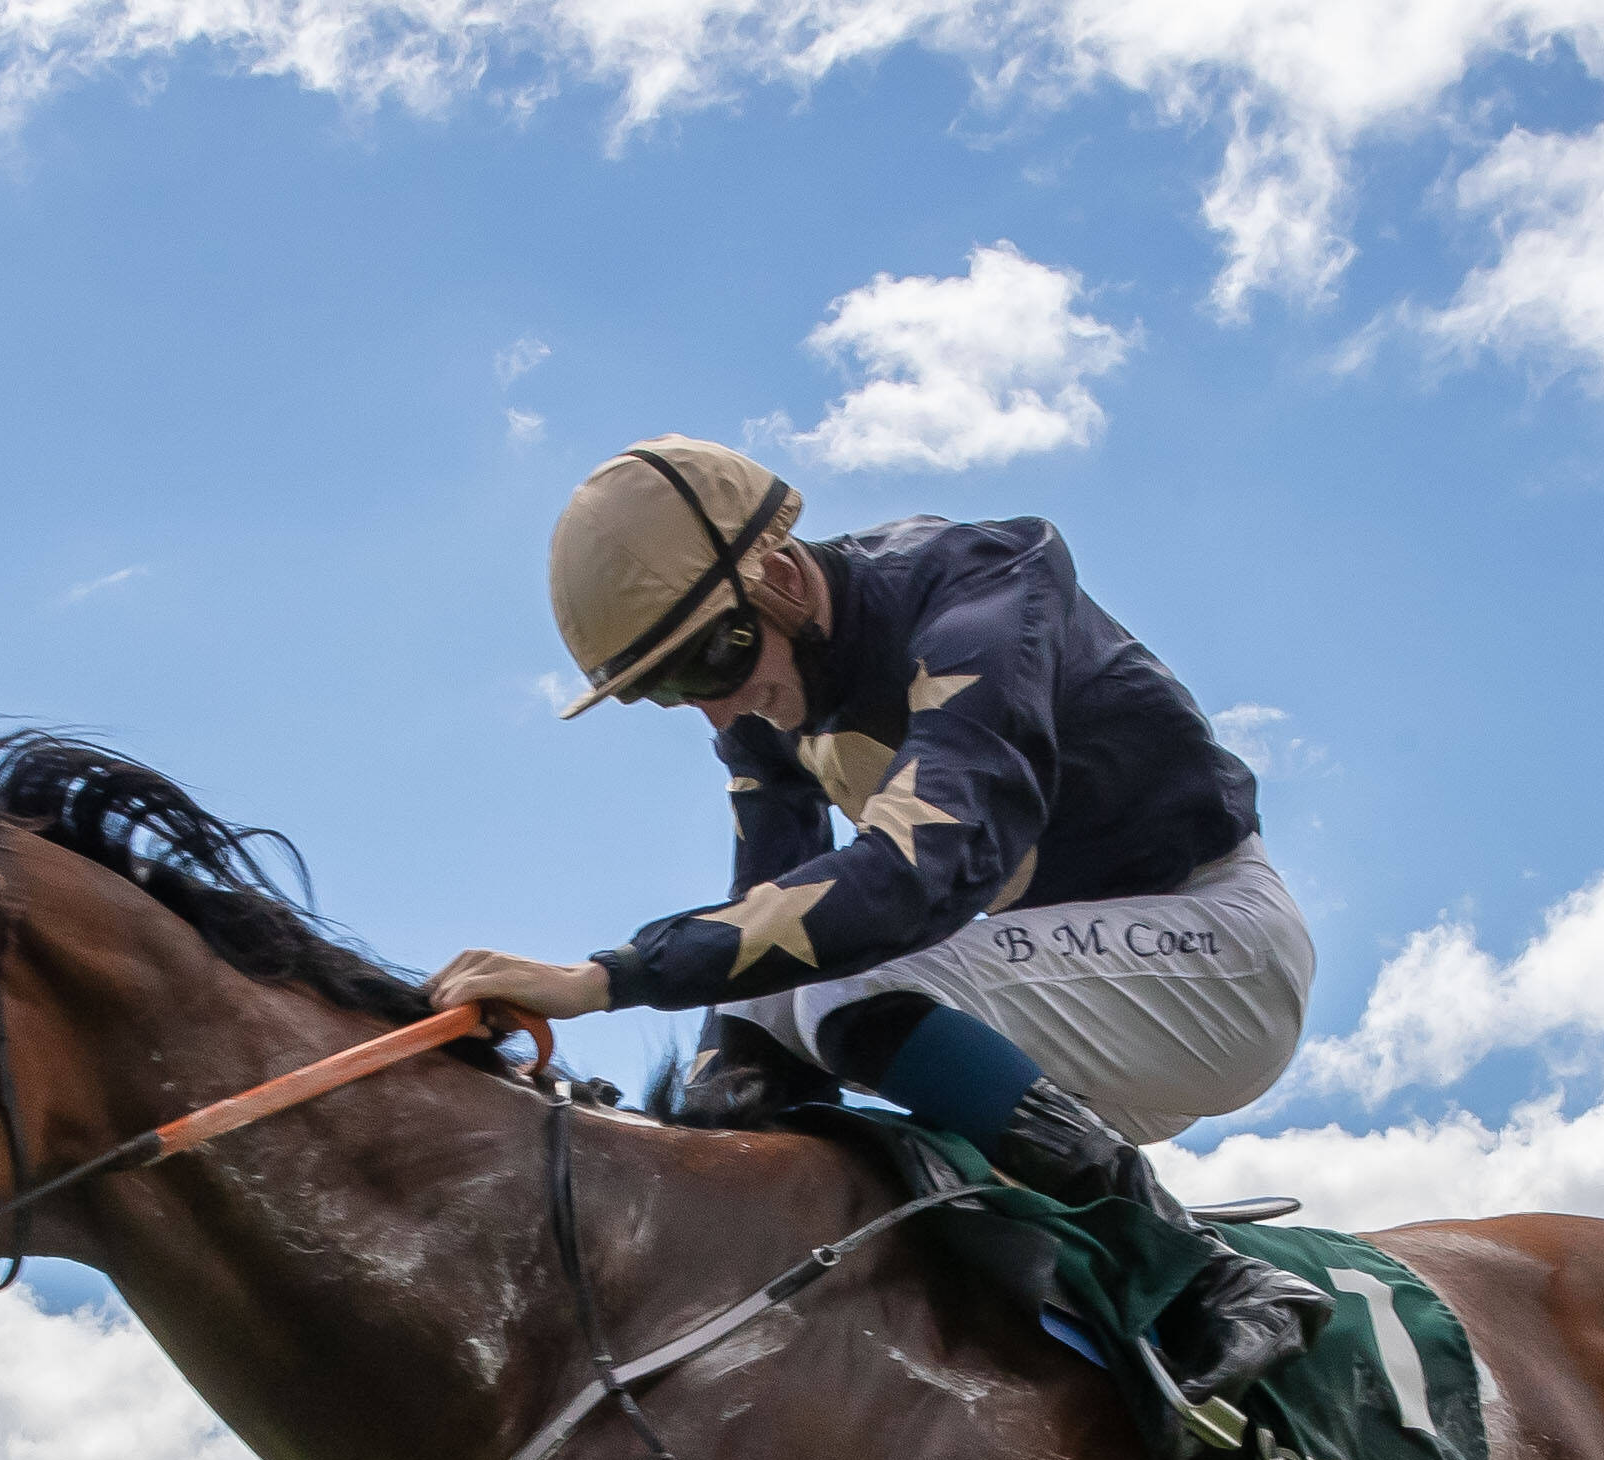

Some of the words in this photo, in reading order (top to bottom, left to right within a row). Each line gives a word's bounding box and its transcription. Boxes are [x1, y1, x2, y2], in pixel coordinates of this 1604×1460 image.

[995, 926, 1035, 963] B
[1052, 919, 1107, 958] M
[1125, 922, 1221, 958] Coen
[1326, 1267, 1437, 1437] 1
